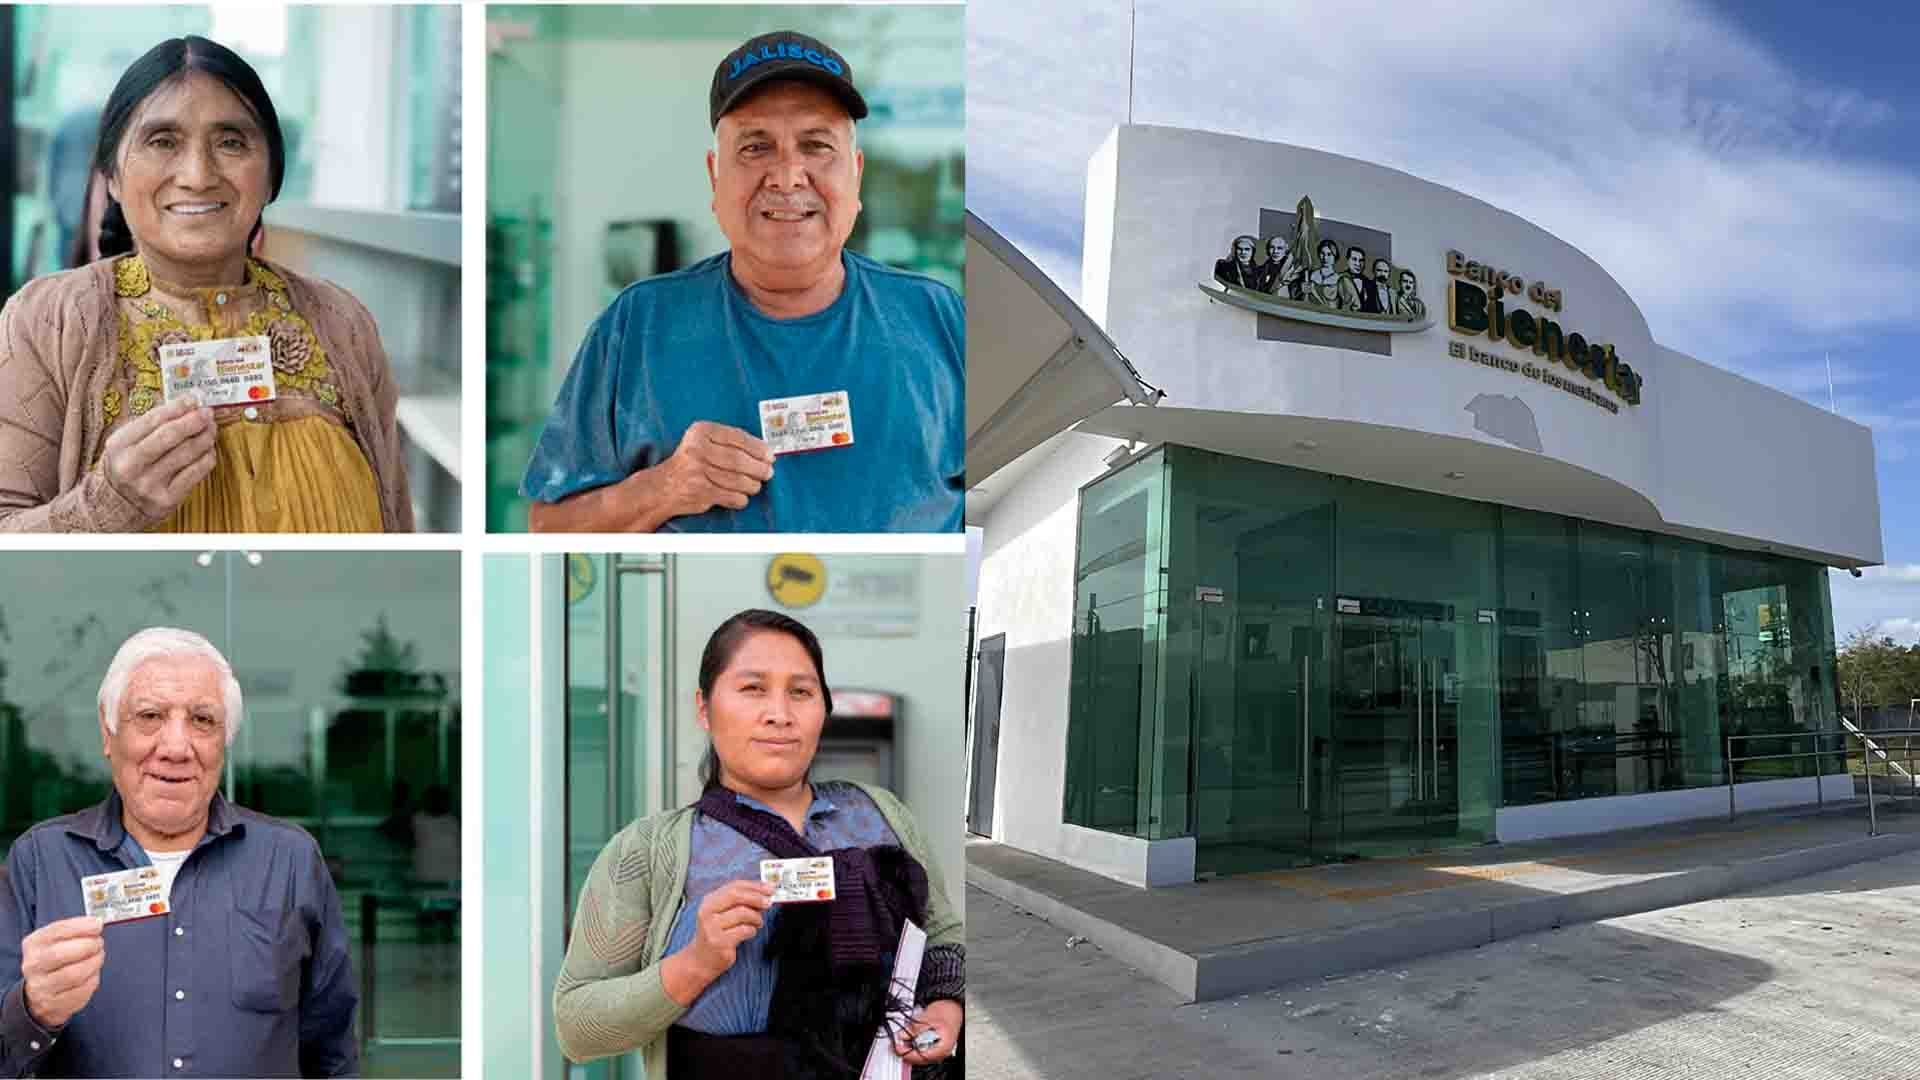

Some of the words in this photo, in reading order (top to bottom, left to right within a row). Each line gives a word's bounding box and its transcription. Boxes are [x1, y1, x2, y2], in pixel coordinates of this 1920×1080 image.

[728, 41, 843, 80] JALISCO
[1446, 250, 1523, 294] Banco
[1528, 281, 1562, 312] del
[1449, 280, 1643, 405] Bienestar
[1449, 341, 1466, 359] El
[1469, 346, 1520, 372] banco
[1522, 362, 1541, 380] de
[1543, 369, 1562, 389] los
